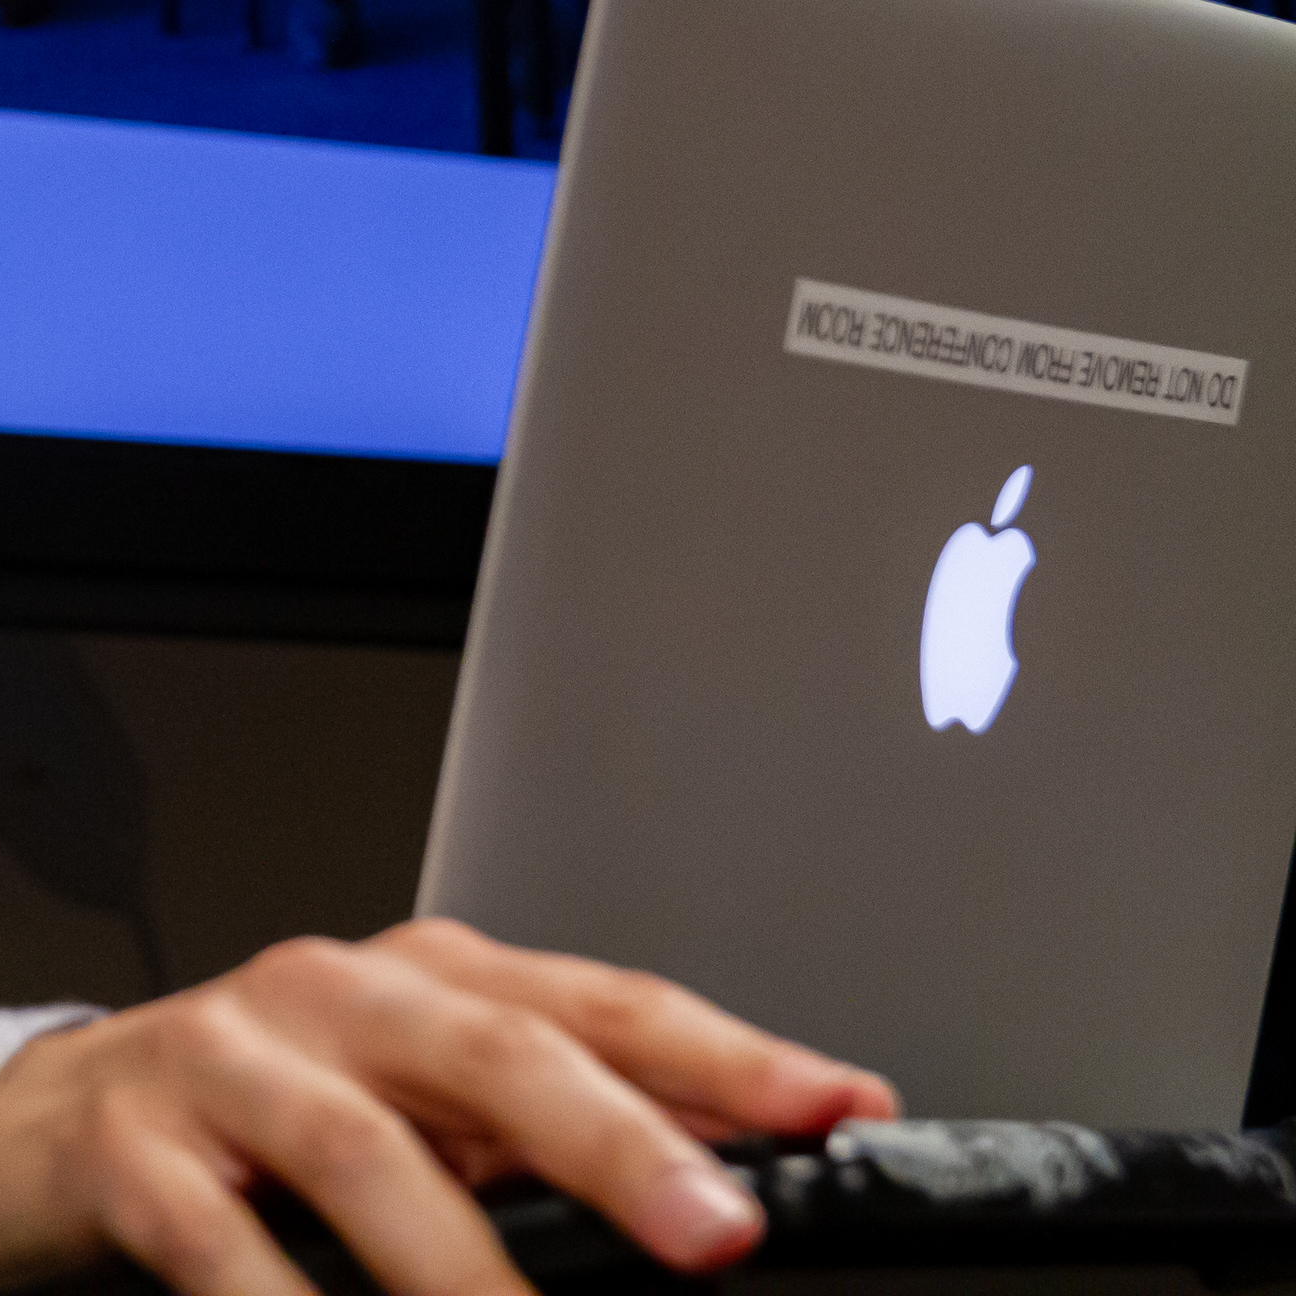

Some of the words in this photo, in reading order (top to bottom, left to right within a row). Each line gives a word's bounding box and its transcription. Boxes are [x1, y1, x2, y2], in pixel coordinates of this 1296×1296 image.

[798, 302, 864, 346] ROOM
[869, 312, 1011, 373] CONFERENCE
[1015, 340, 1076, 384] FROM
[1077, 351, 1163, 397] REMOVE
[1163, 367, 1205, 401] NOT
[1208, 371, 1237, 409] DO
